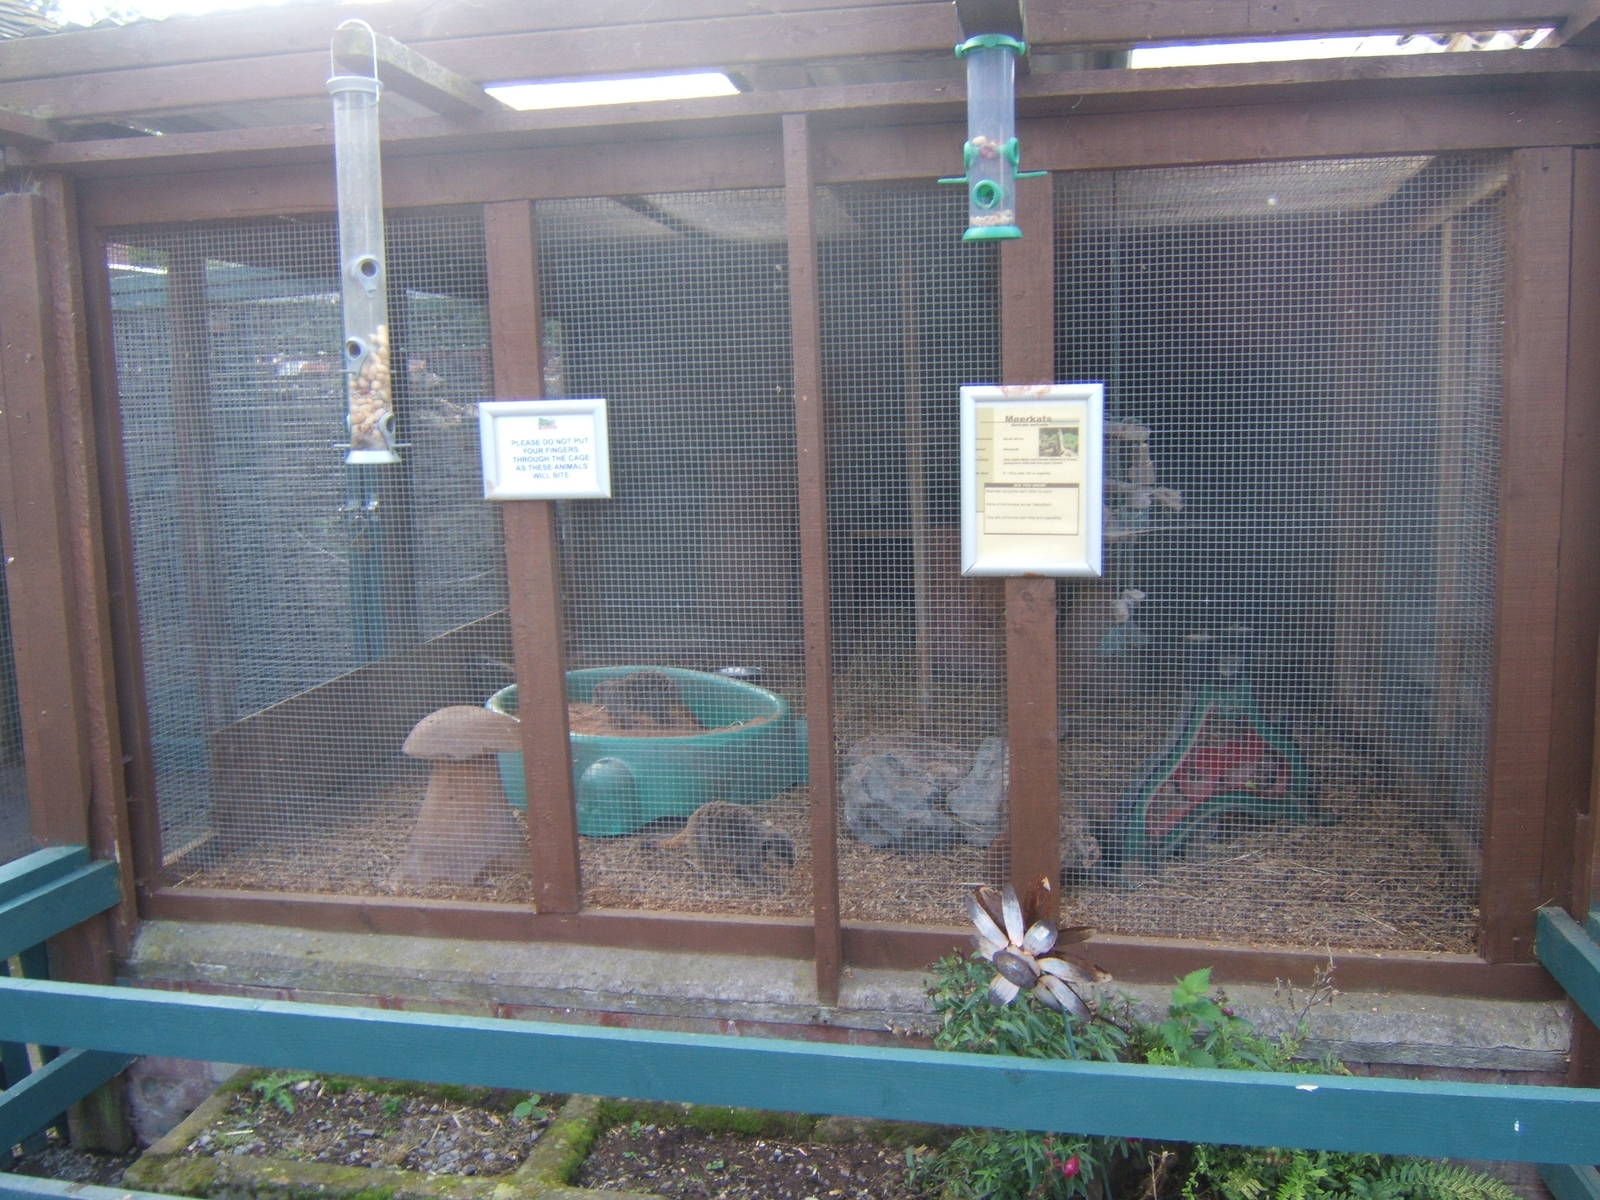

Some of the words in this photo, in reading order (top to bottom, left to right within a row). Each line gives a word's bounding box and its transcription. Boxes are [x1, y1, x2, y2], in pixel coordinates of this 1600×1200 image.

[1005, 415, 1052, 424] Meerkats
[545, 446, 579, 454] FINGERS
[528, 463, 552, 471] THESE
